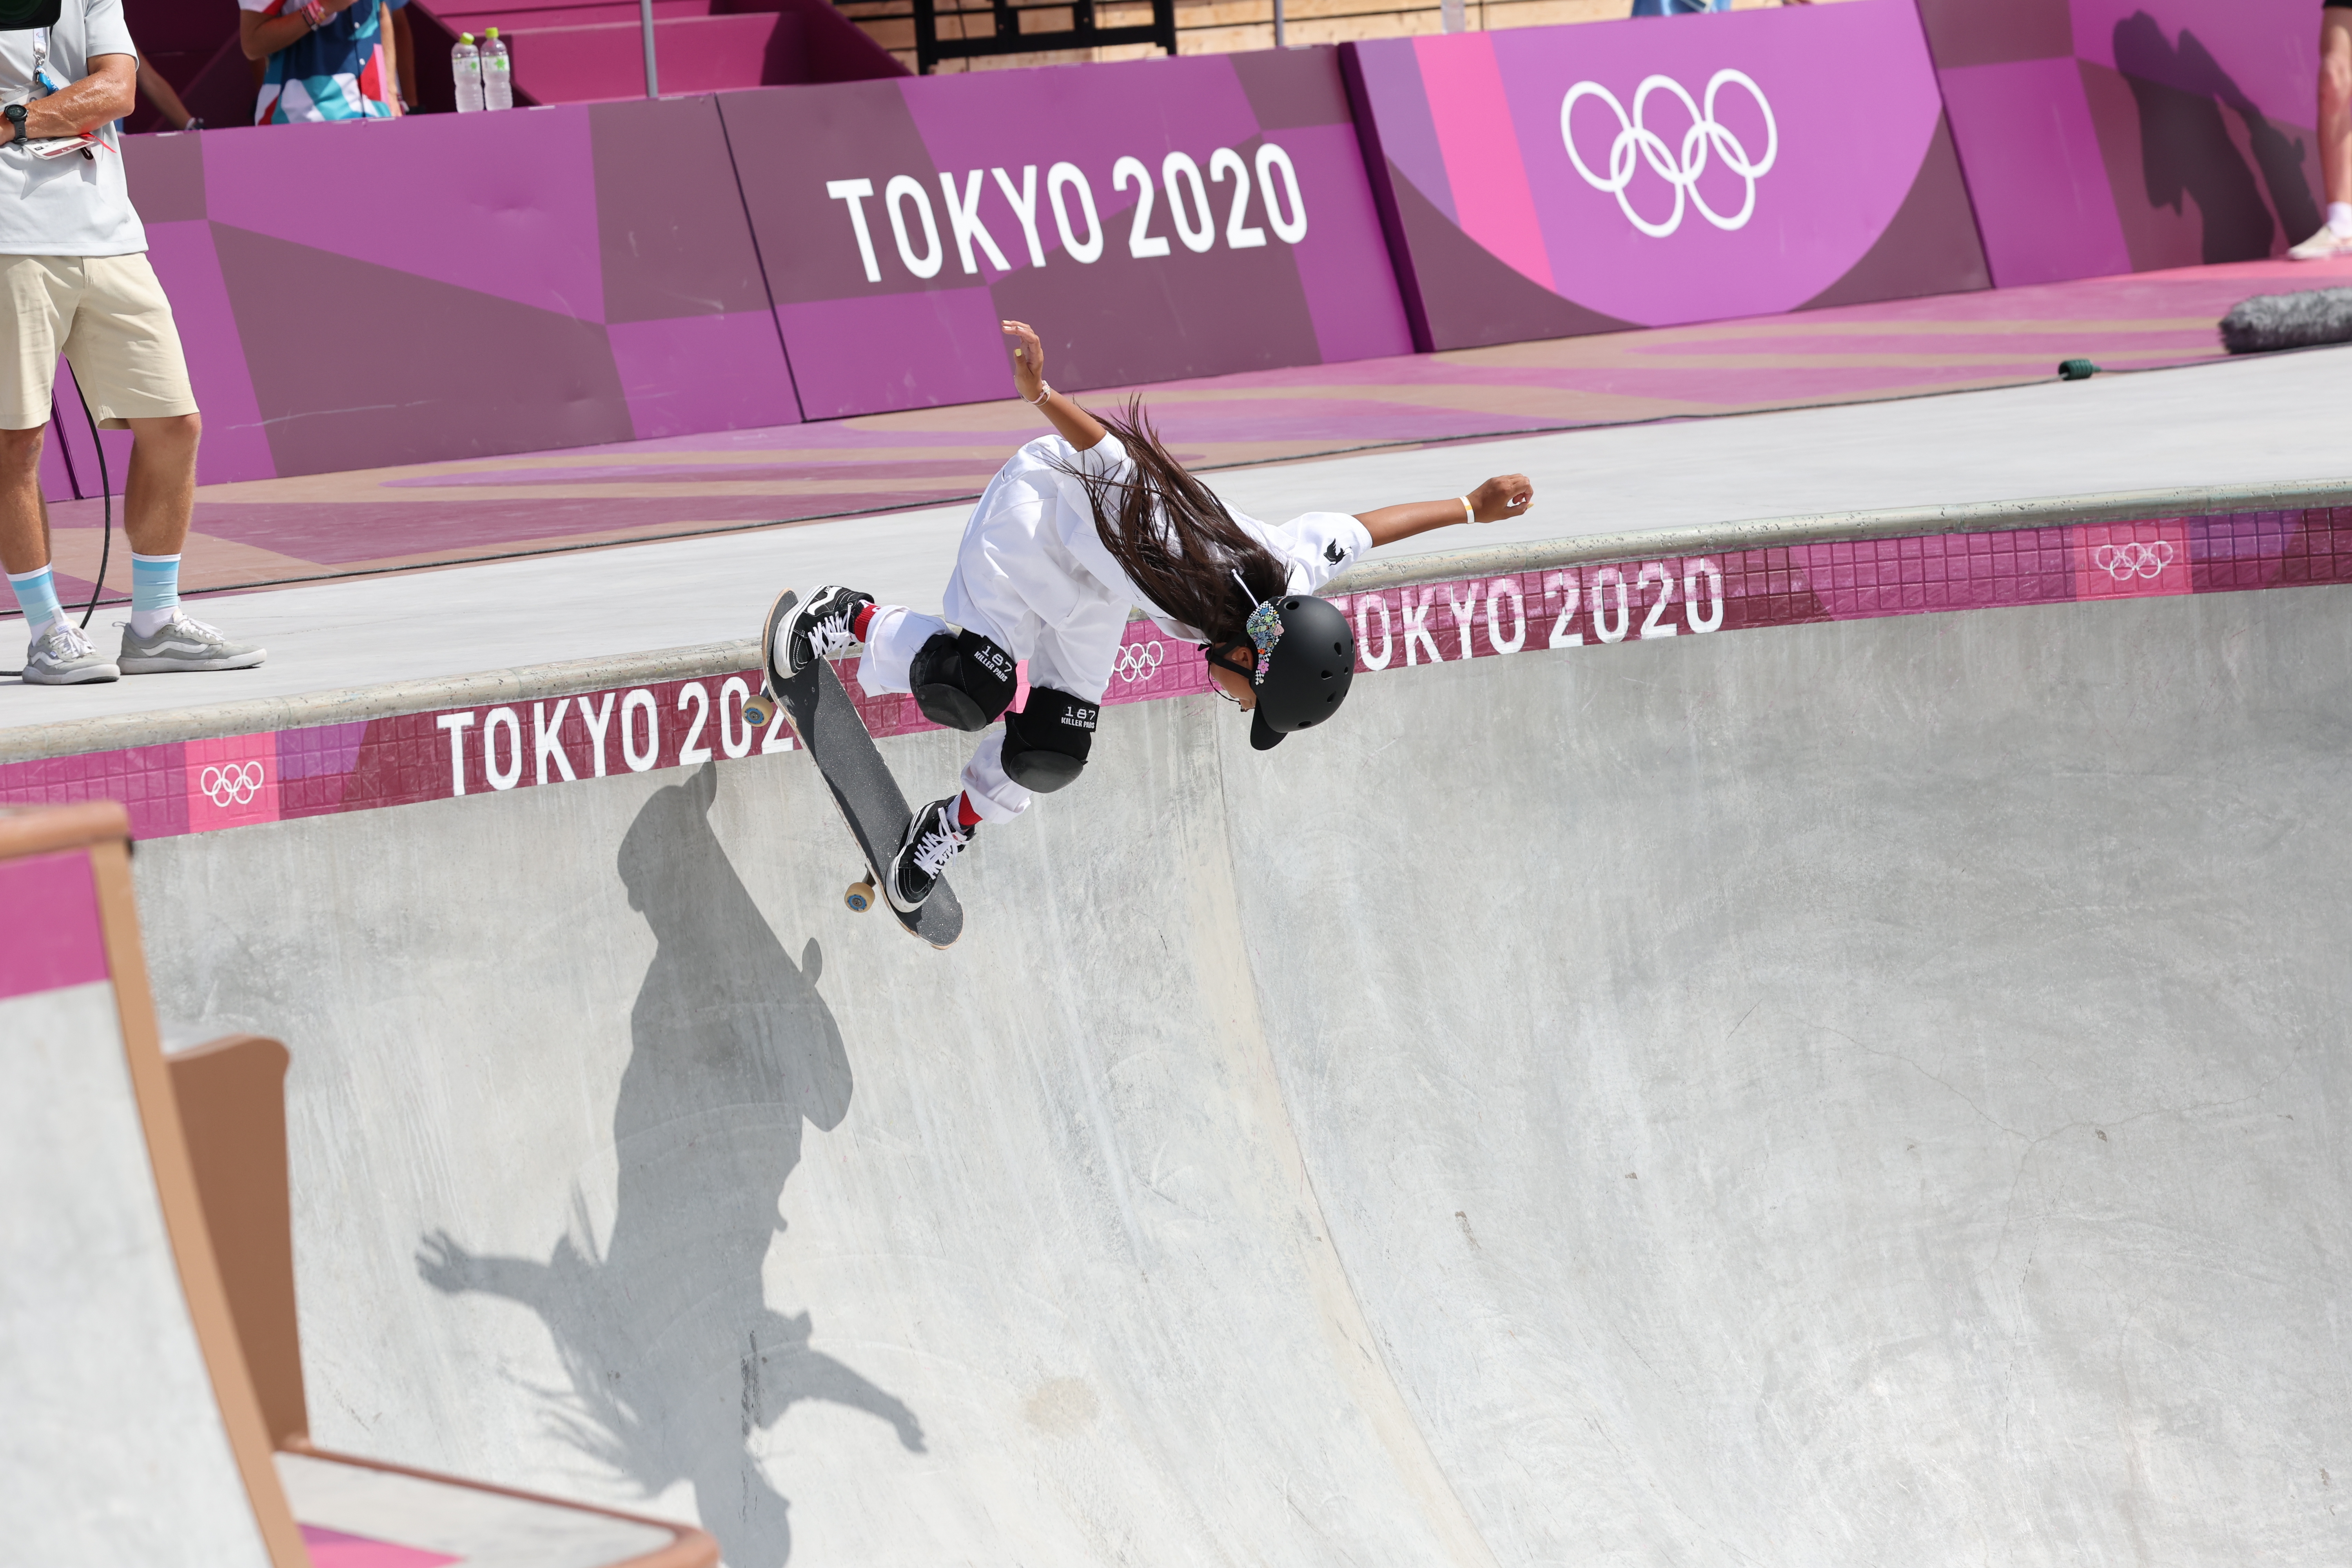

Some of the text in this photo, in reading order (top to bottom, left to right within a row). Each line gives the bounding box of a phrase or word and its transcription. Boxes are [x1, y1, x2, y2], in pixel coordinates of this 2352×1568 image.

[826, 143, 1307, 282] TOKYO 2020
[1325, 558, 1723, 671] OKYO 2020
[974, 651, 1007, 682] KILLER PADS
[982, 645, 1012, 672] 187
[1061, 717, 1082, 727] KILLER
[1065, 706, 1095, 720] 187
[437, 676, 794, 796] TOKYO 202
